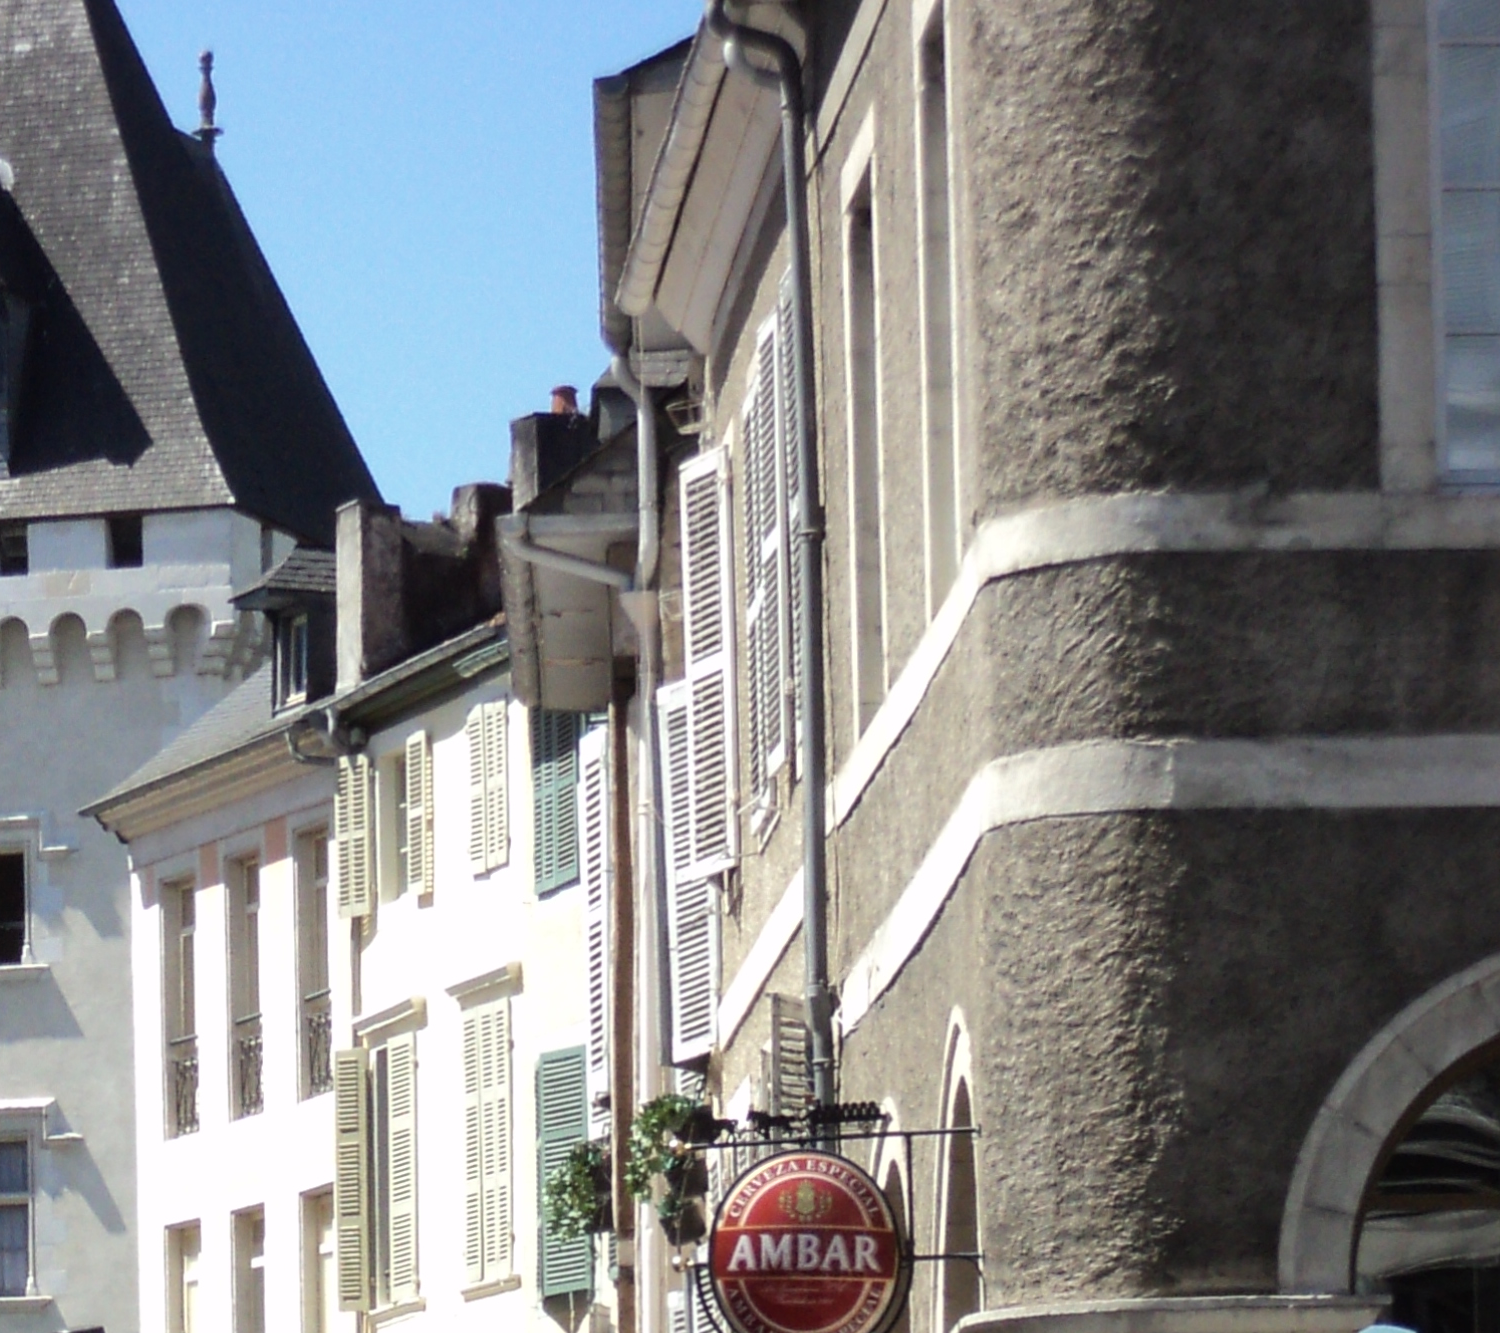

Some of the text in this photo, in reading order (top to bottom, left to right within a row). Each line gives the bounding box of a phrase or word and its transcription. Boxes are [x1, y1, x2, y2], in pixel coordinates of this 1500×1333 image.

[729, 1158, 882, 1219] CERVEZA ESPECIAL
[727, 1232, 883, 1273] AMBAR
